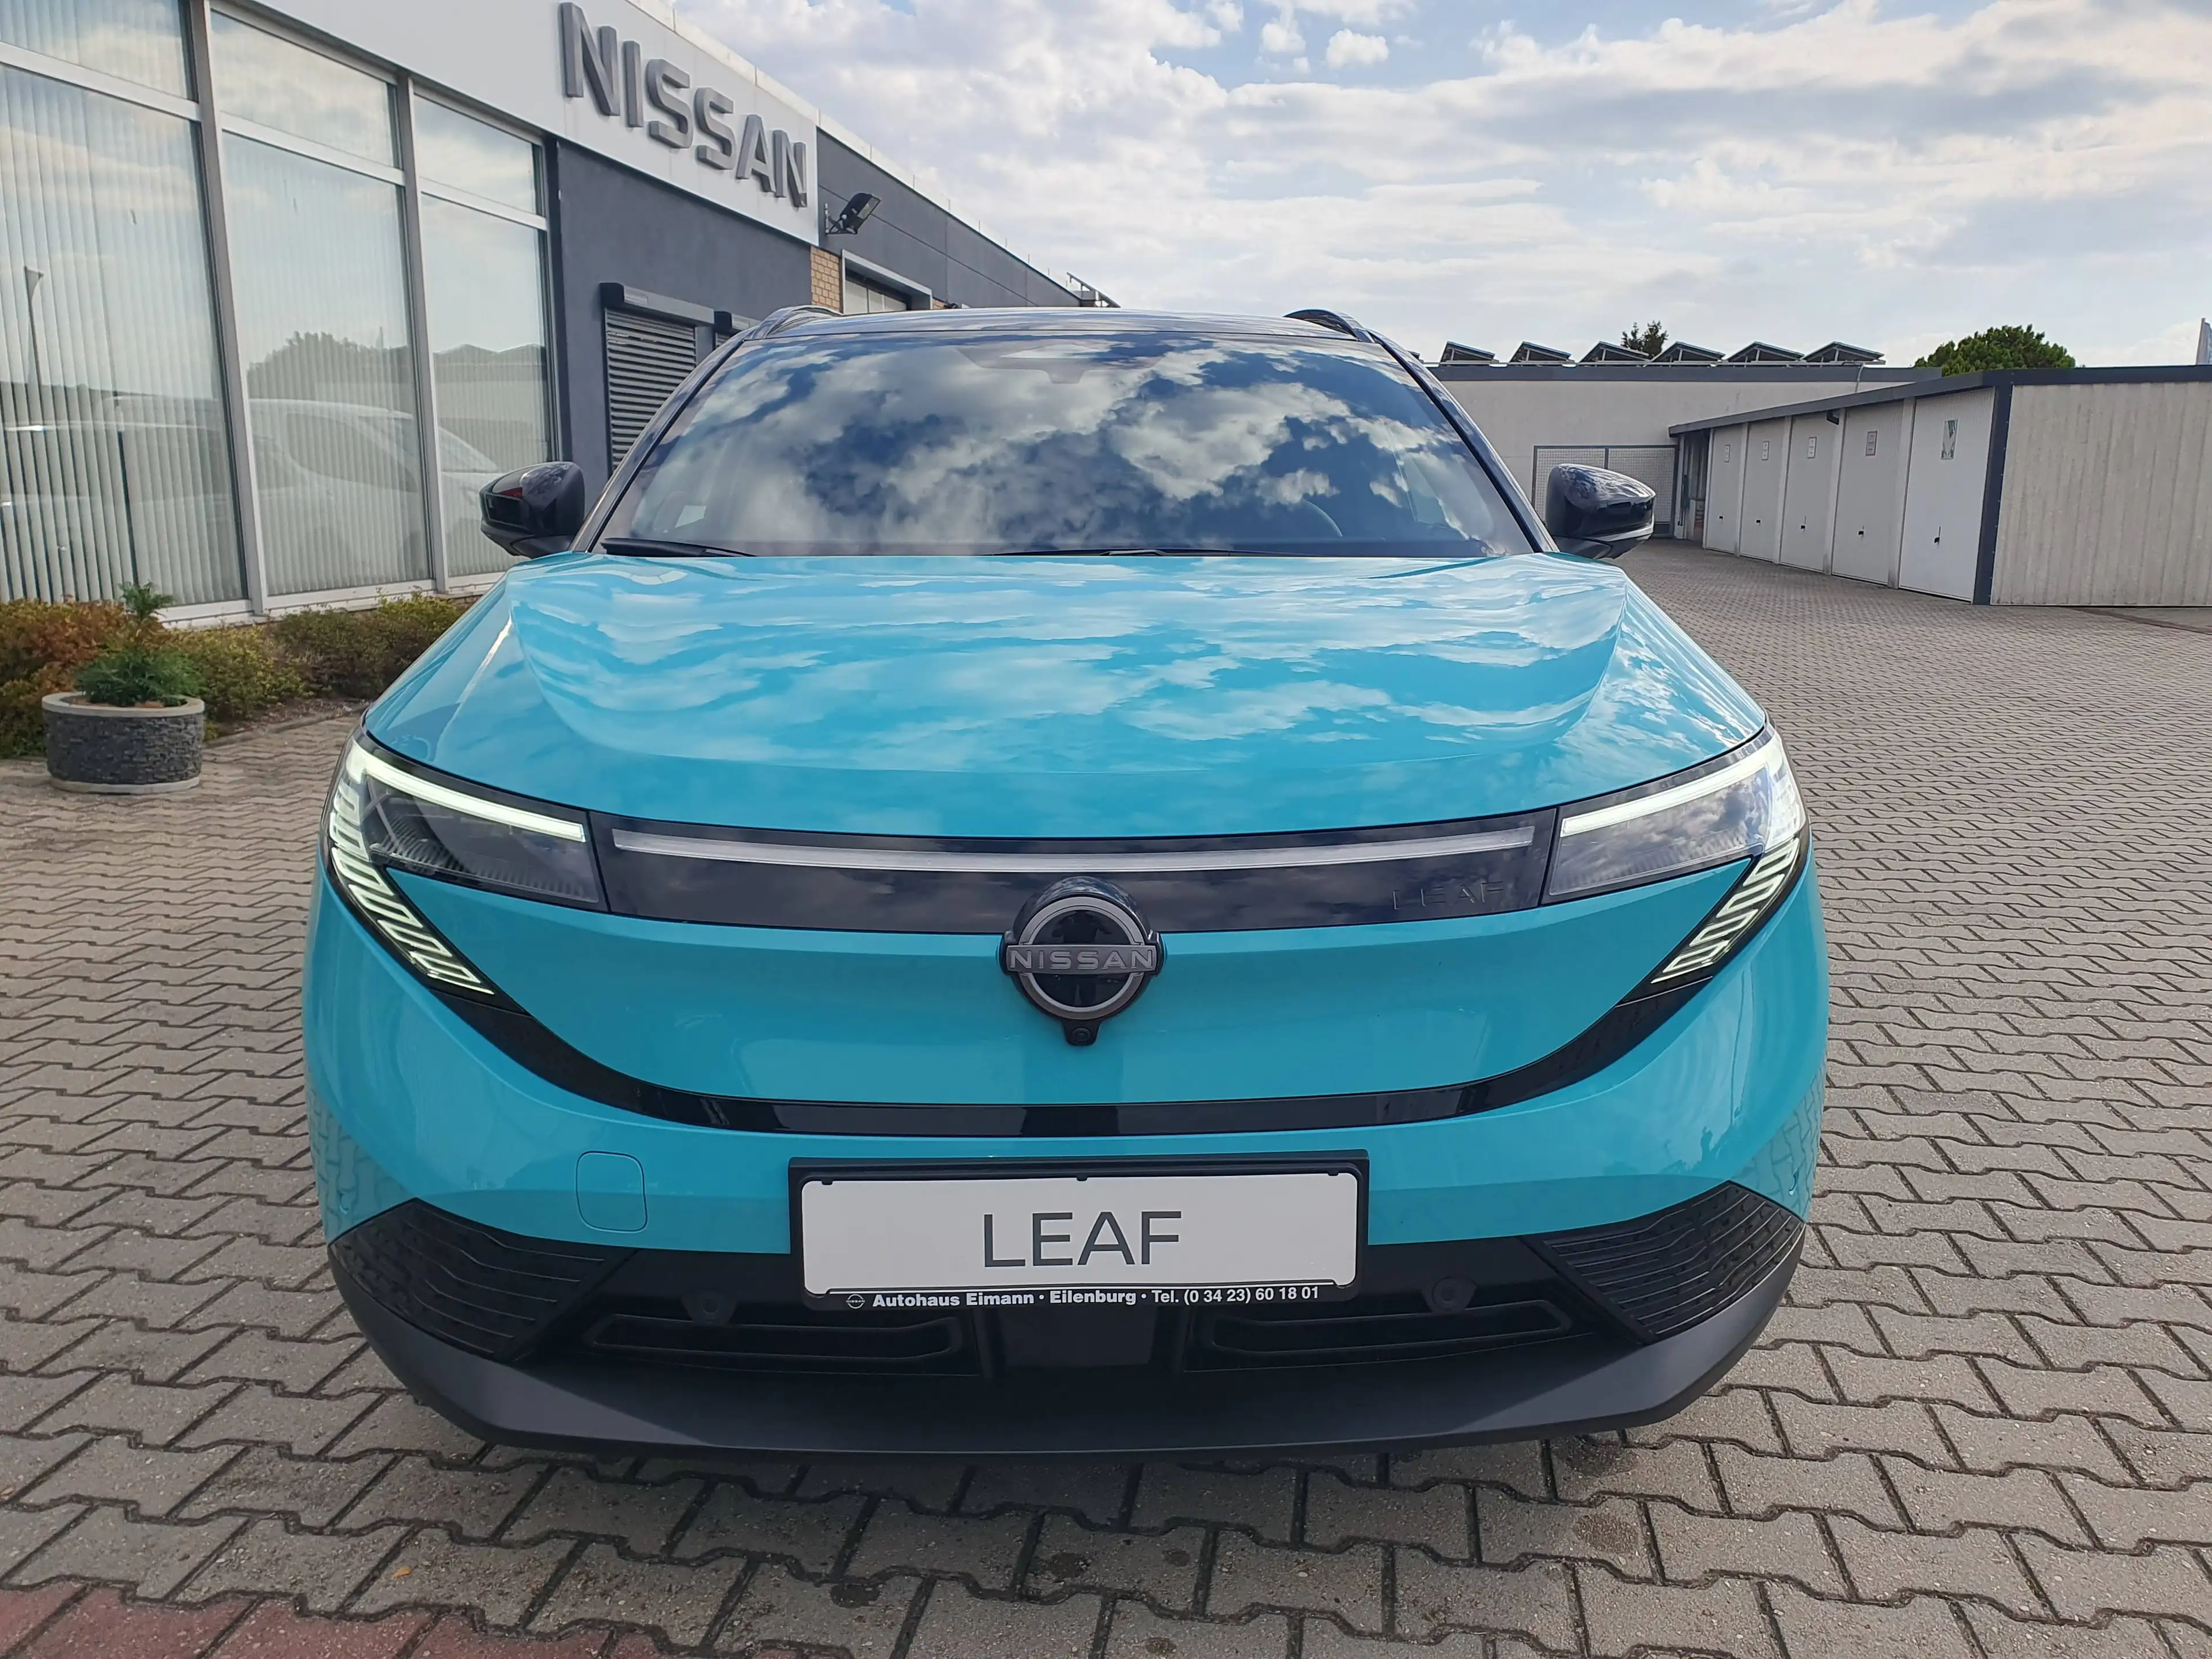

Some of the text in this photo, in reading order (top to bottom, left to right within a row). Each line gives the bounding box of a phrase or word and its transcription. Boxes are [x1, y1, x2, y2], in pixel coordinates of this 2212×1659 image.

[560, 2, 808, 207] NISSAN
[1392, 880, 1504, 911] LEAF
[1009, 949, 1153, 970] NISSAN
[983, 1210, 1183, 1268] LEAF
[872, 1286, 1319, 1307] Autohaus Eimann Eilenburg Tel. (0 34 23) 60 18 01
